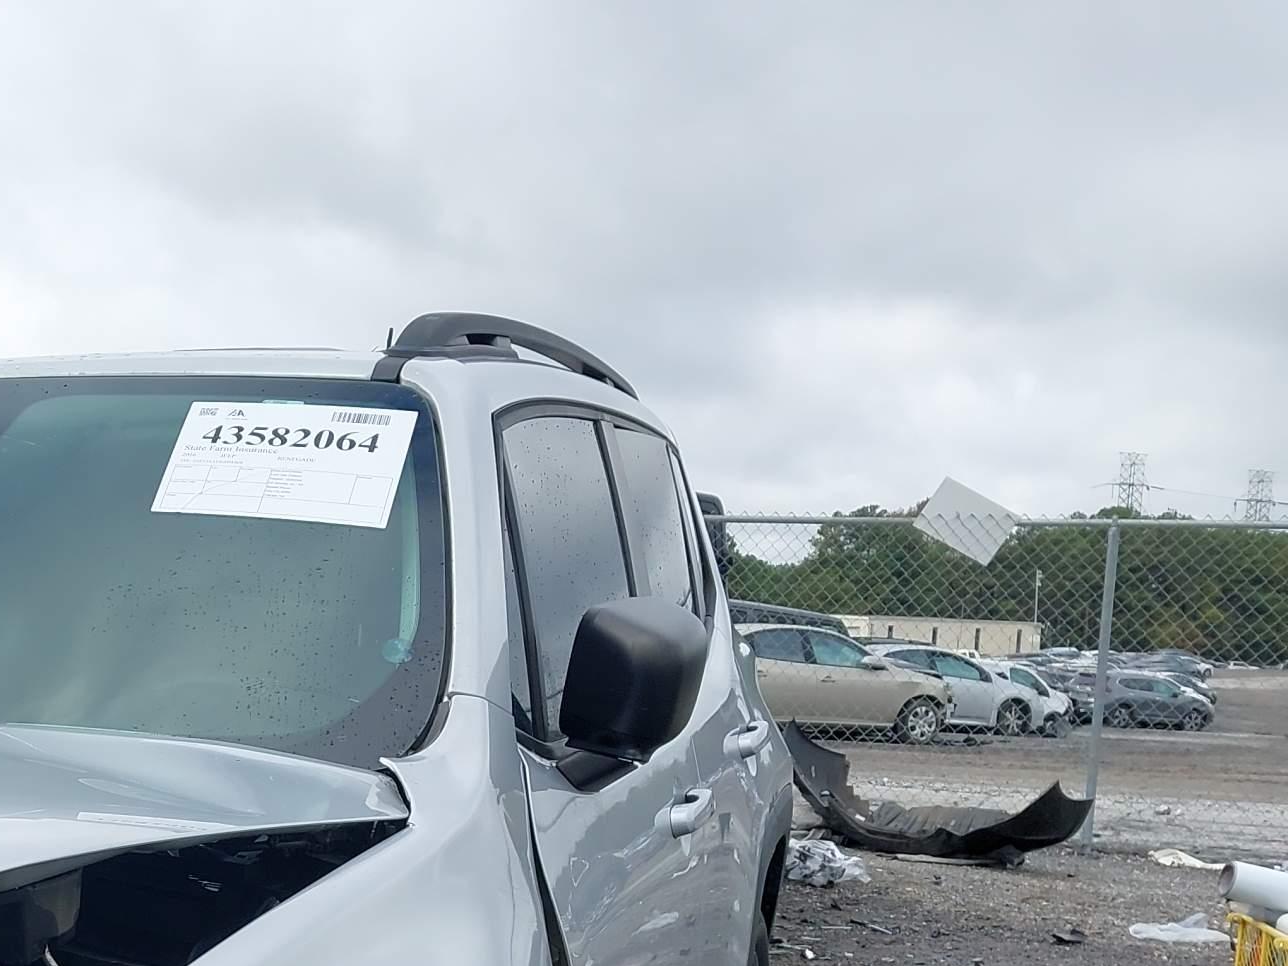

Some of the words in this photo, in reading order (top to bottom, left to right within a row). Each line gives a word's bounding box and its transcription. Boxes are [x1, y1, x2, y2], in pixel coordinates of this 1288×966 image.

[202, 425, 379, 453] 43582064
[184, 444, 207, 452] State
[209, 445, 233, 453] Farm
[235, 446, 279, 455] Insurance
